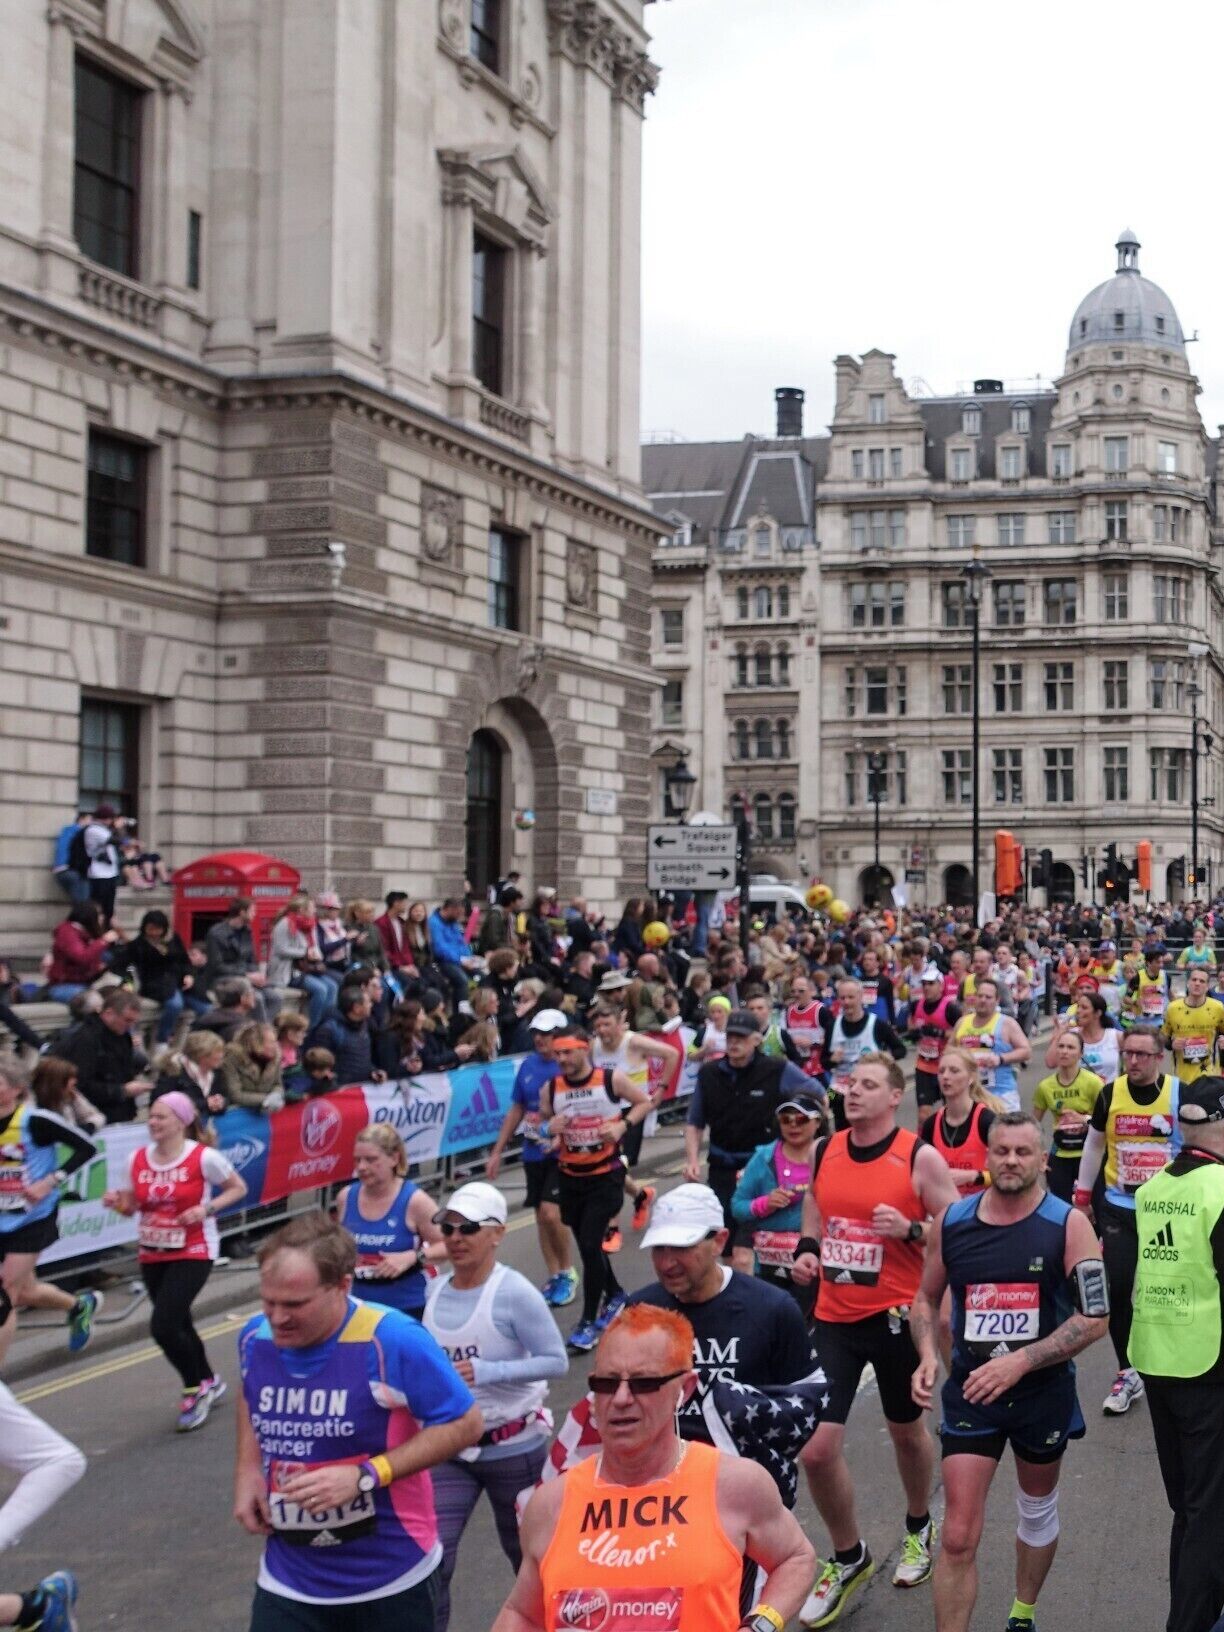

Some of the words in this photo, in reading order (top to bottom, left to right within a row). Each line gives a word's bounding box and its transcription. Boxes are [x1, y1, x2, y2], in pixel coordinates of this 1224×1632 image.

[681, 830, 733, 842] Trafalgar
[687, 843, 727, 853] Square
[655, 862, 704, 873] Lambeth
[660, 875, 697, 886] Bridge
[1124, 1168, 1160, 1181] 3667
[1144, 1200, 1197, 1216] MARSHAL
[822, 1241, 878, 1266] 33341
[1143, 1246, 1179, 1262] adidas
[999, 1291, 1037, 1303] money
[1145, 1286, 1175, 1296] LONDON
[974, 1313, 1029, 1336] 7202
[692, 1337, 741, 1364] AM
[257, 1385, 349, 1417] SIMON
[251, 1412, 356, 1438] Pancreatic
[580, 1495, 689, 1533] MICK
[562, 1588, 607, 1628] Virgin
[611, 1598, 679, 1621] money
